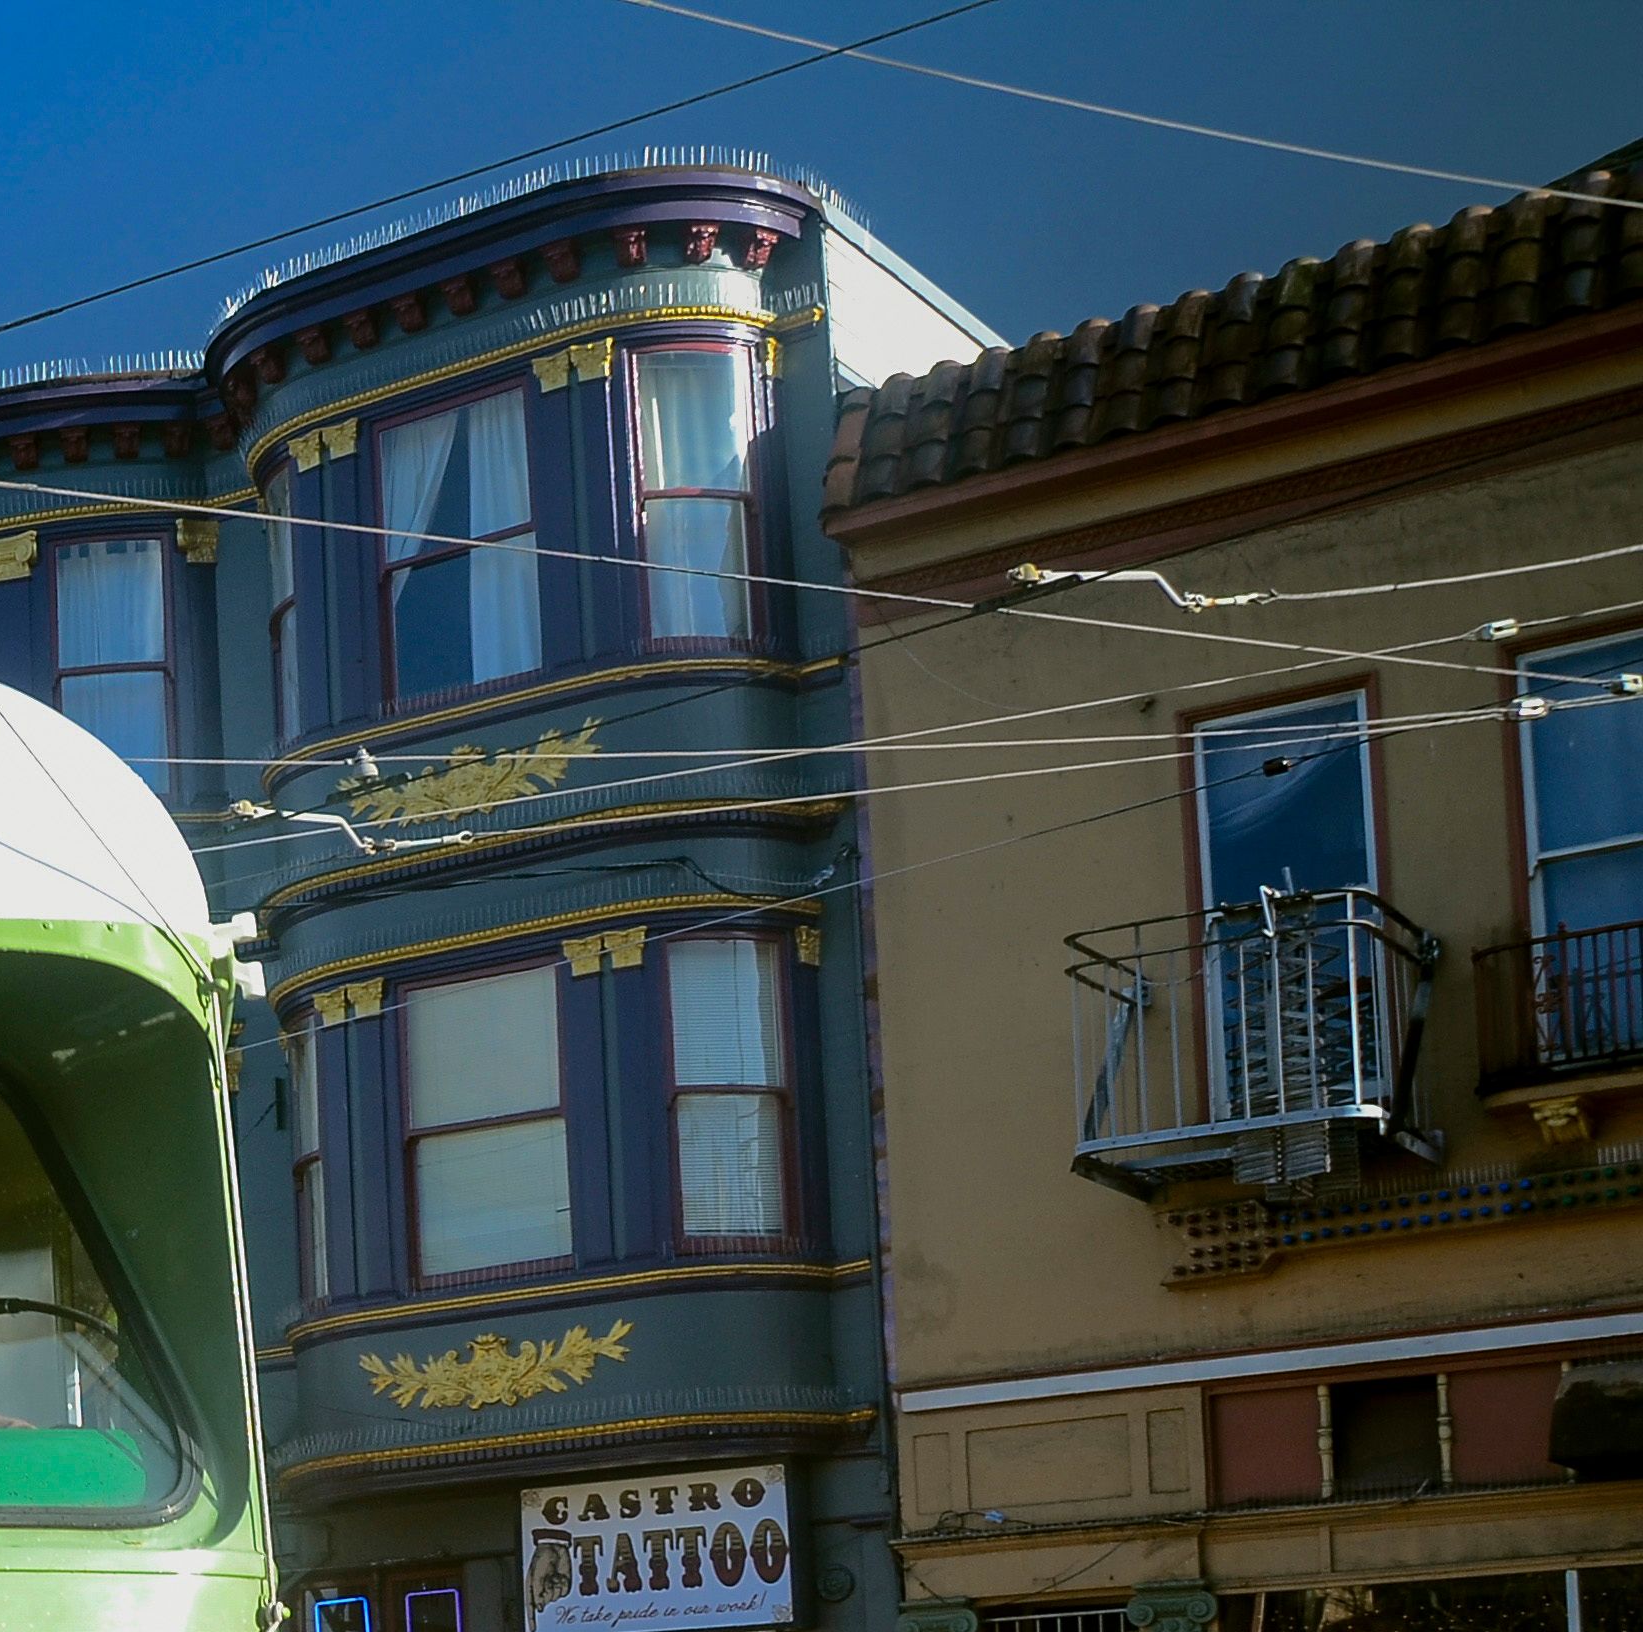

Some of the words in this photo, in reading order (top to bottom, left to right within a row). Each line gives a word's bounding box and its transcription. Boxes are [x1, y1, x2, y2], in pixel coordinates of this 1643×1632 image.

[542, 1478, 766, 1525] CASTRO
[573, 1518, 790, 1597] TATTOO
[555, 1604, 576, 1624] We
[578, 1606, 612, 1624] take
[611, 1602, 658, 1628] pride
[664, 1606, 678, 1618] in
[684, 1604, 710, 1617] our
[715, 1591, 767, 1614] work!
